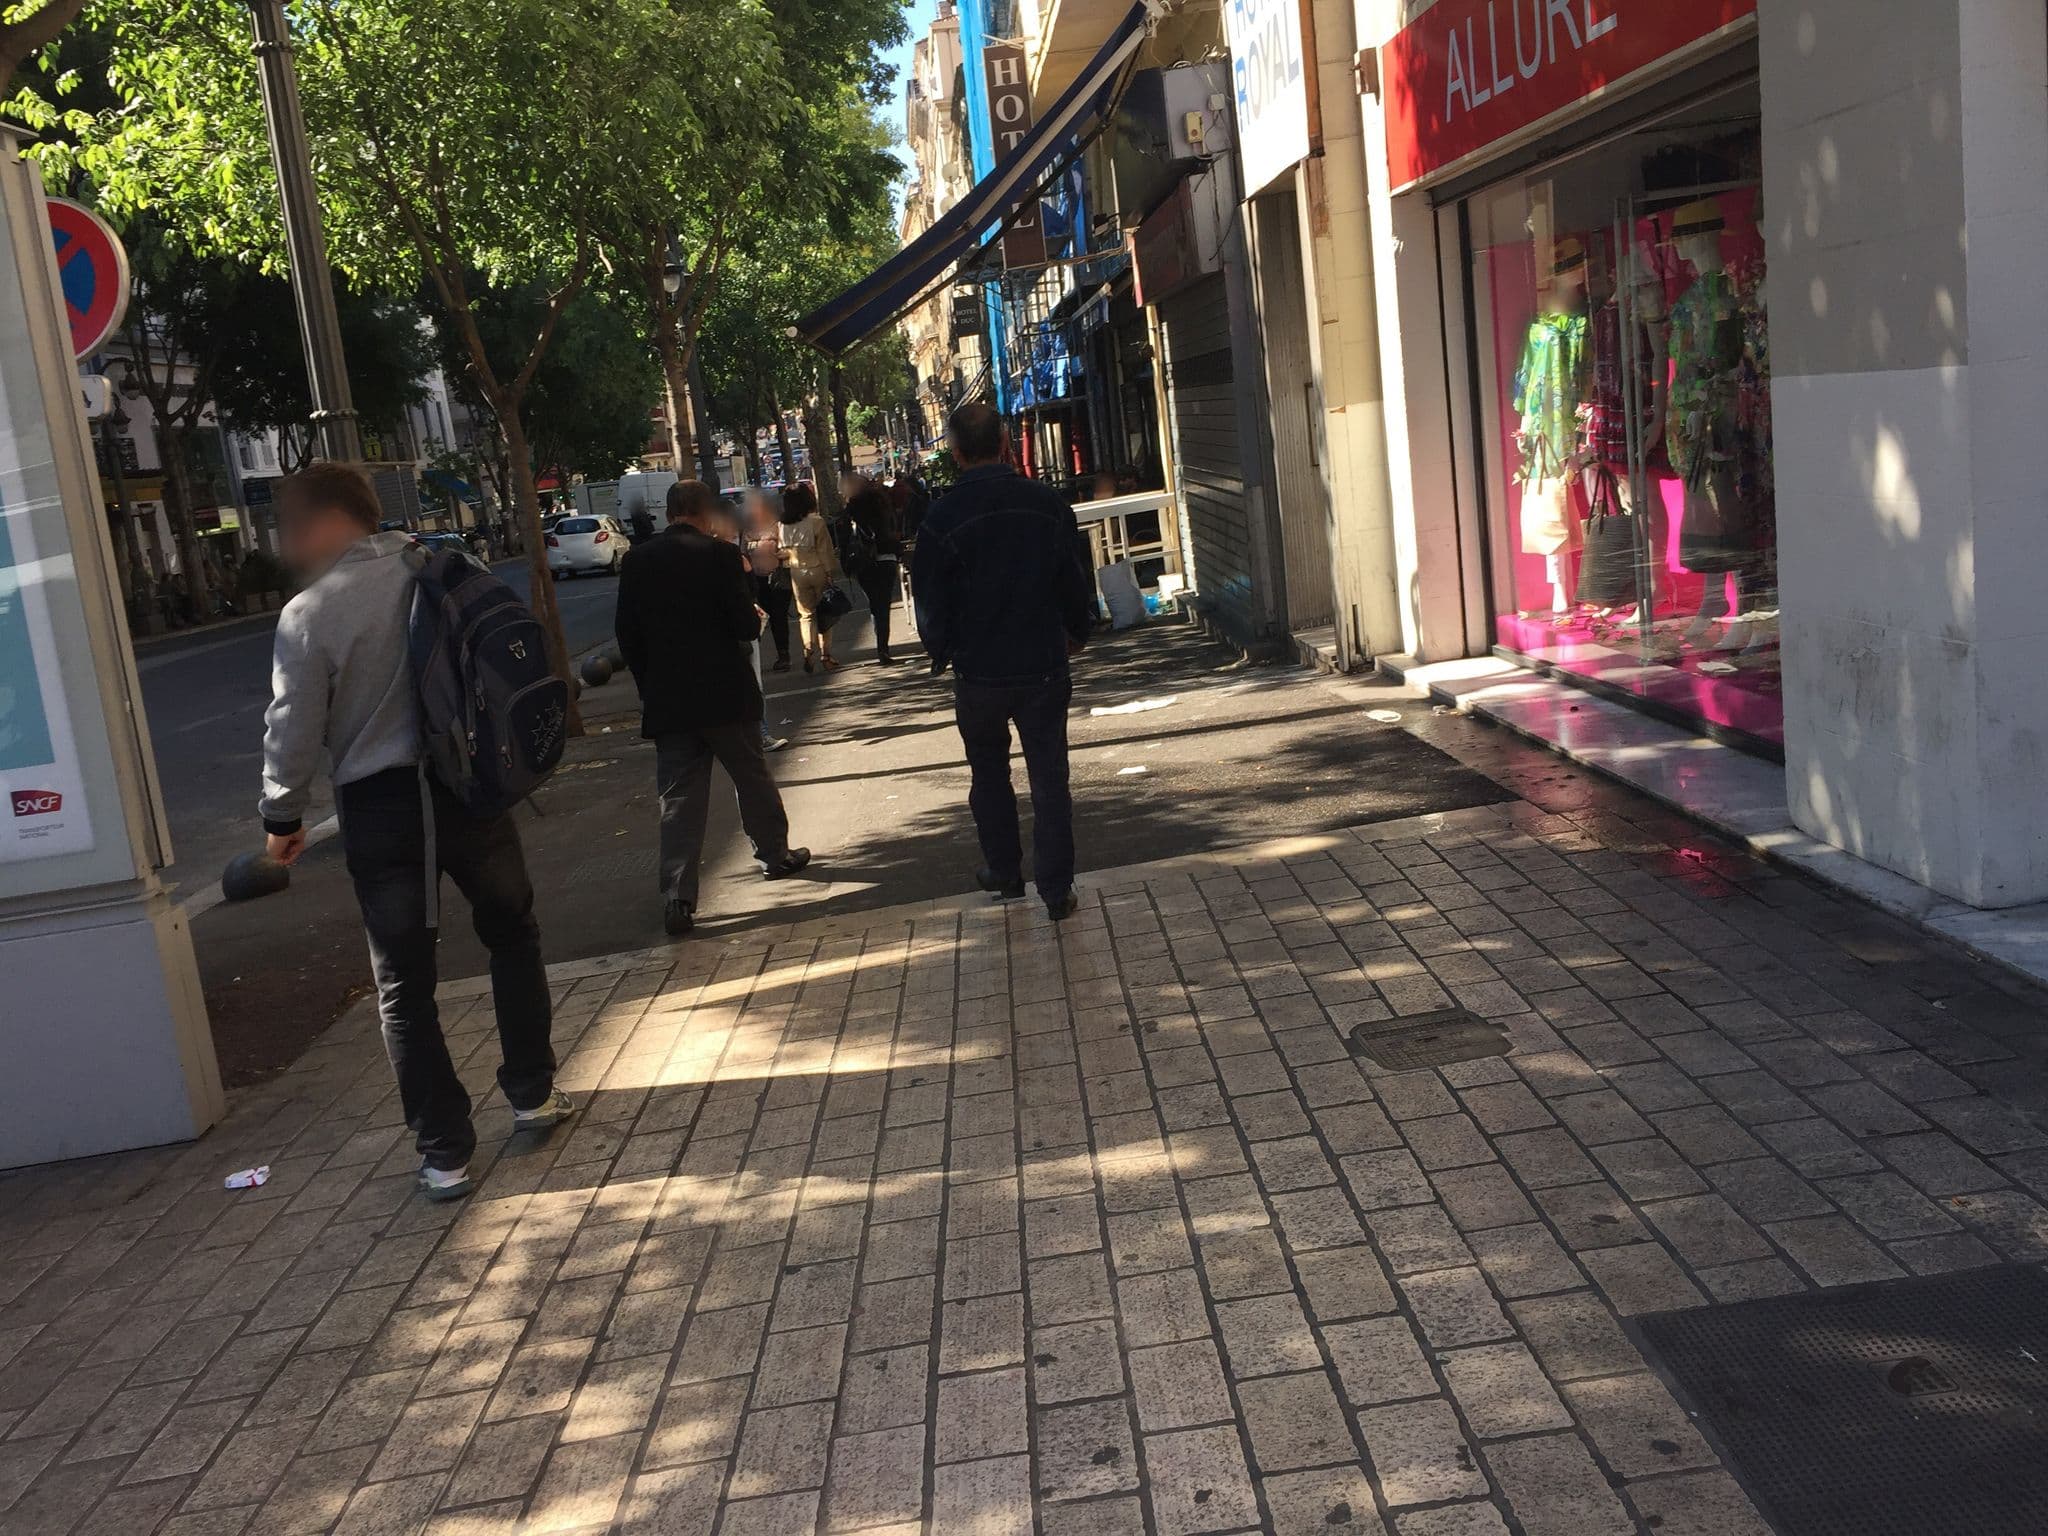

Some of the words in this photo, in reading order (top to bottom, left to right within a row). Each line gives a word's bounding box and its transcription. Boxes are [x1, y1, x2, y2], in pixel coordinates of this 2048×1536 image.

[1235, 1, 1299, 133] ROYAL
[991, 57, 1035, 229] HOTL
[16, 796, 59, 813] SNCF
